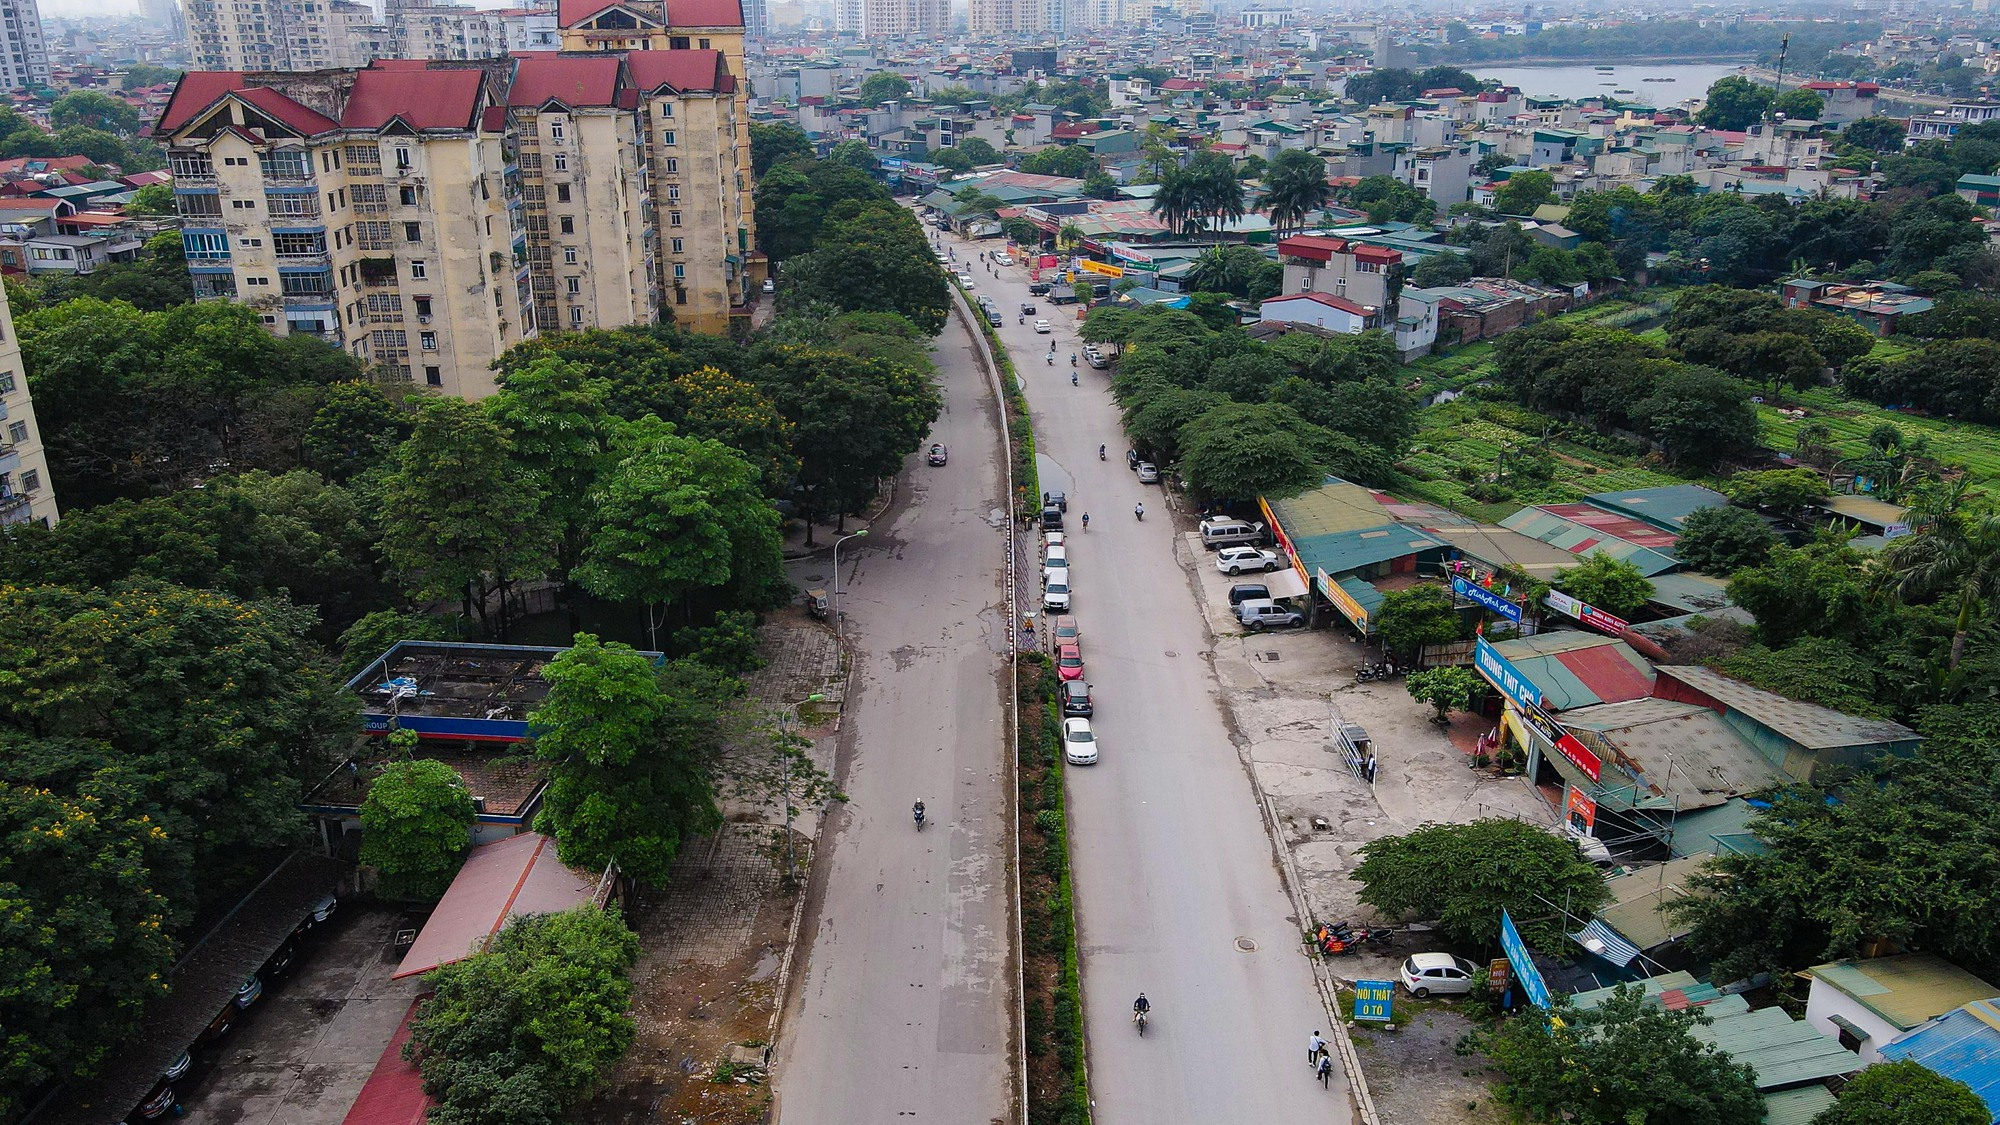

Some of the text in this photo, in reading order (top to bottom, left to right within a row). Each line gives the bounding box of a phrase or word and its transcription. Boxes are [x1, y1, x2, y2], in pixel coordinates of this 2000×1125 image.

[1551, 593, 1568, 606] TOTAL
[1500, 604, 1516, 616] Auto
[1481, 648, 1503, 680] TRUNG
[1503, 669, 1519, 695] THỊT
[1357, 985, 1391, 1003] NỘI THẤT
[1363, 1003, 1383, 1015] Ô TÔ
